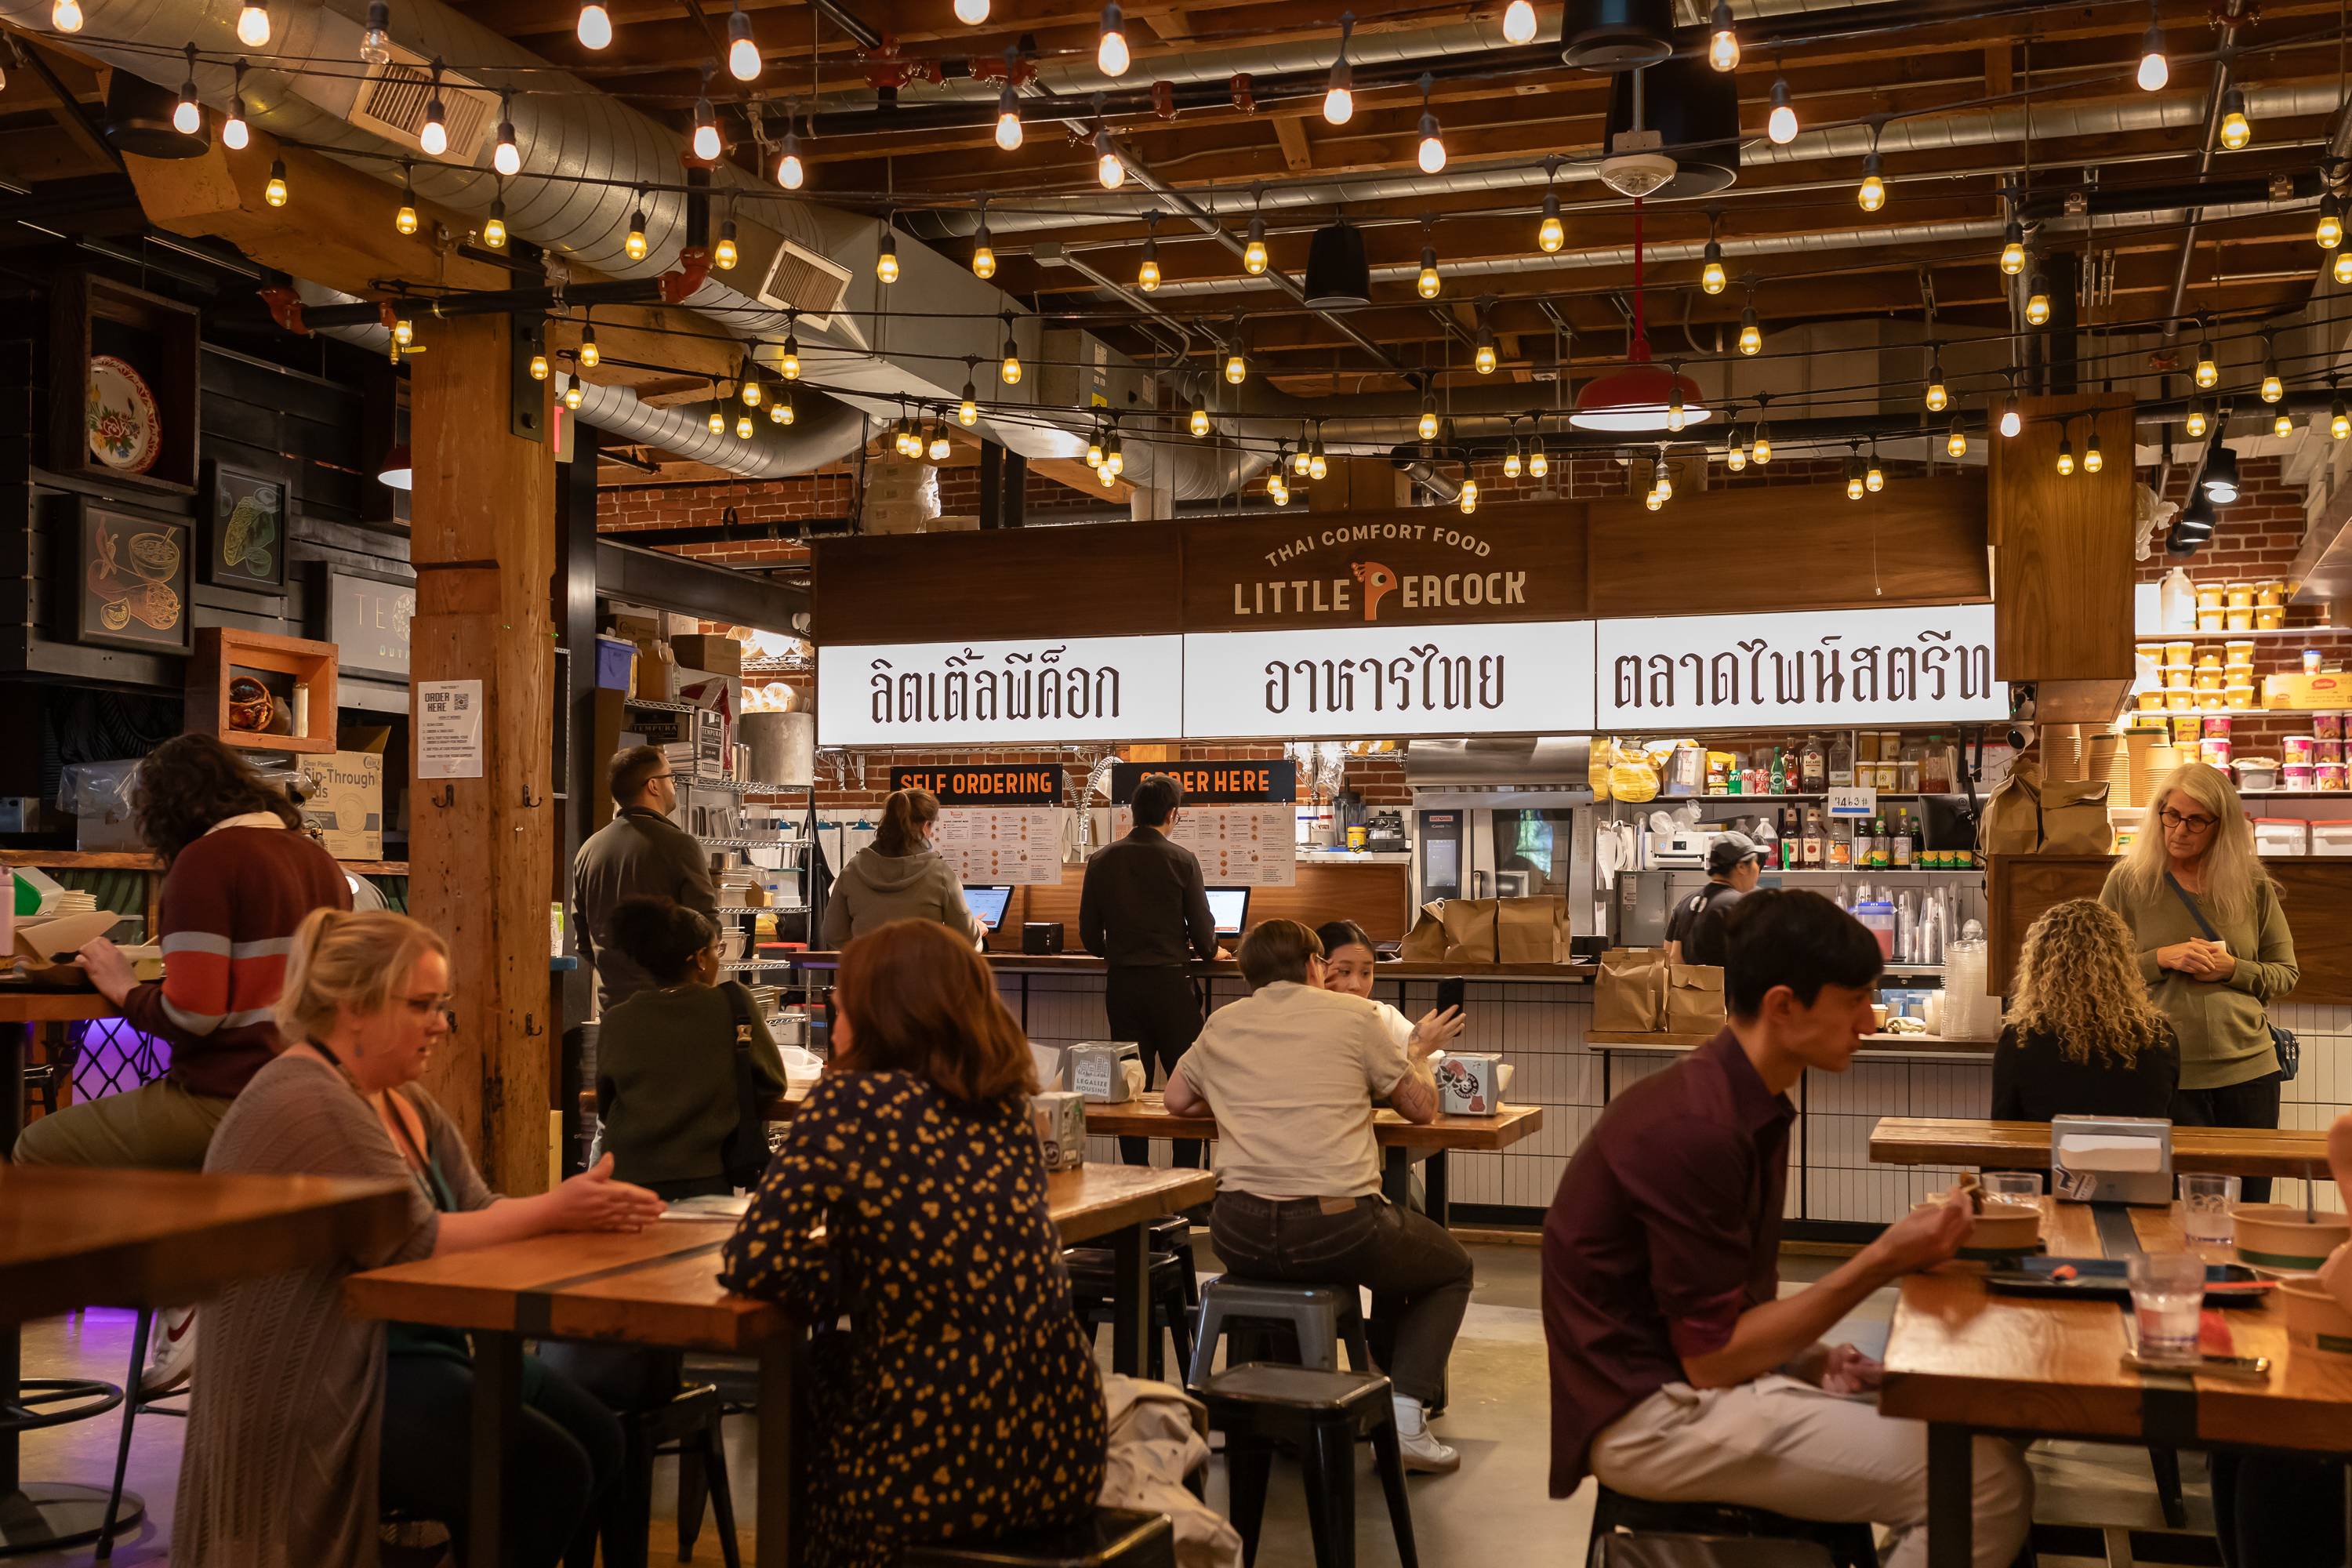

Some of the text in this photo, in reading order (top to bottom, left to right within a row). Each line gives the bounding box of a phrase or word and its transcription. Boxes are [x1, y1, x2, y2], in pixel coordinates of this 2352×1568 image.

[1265, 524, 1491, 567] THAI COMFORT FOOD
[1234, 579, 1350, 615] LITTLE
[1264, 643, 1504, 714] อาหารไทย
[425, 692, 449, 702] ORDER
[427, 702, 447, 712] HERE
[702, 728, 721, 737] TEMPURA
[953, 772, 1052, 794] ORDERING
[1214, 770, 1269, 792] HERE
[1076, 1078, 1108, 1087] LEGALIZE
[1076, 1085, 1107, 1094] HOUSING
